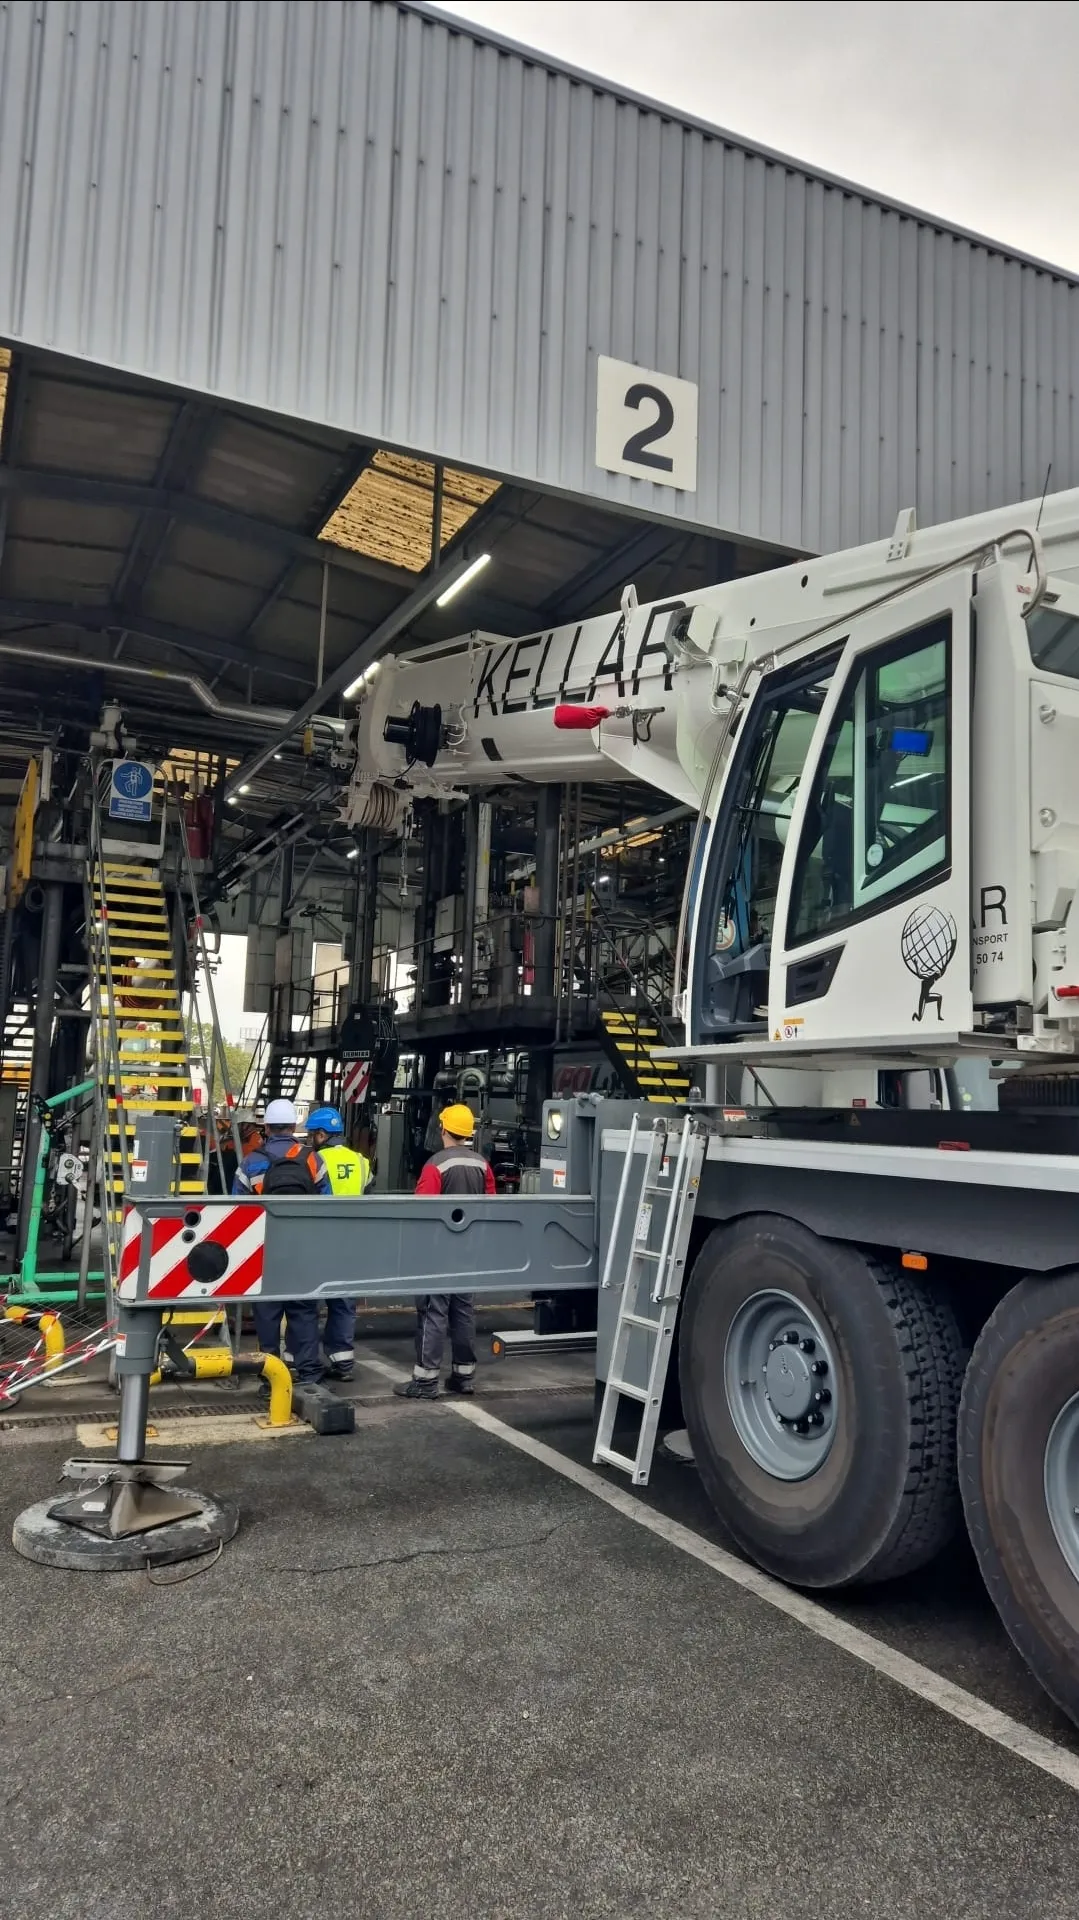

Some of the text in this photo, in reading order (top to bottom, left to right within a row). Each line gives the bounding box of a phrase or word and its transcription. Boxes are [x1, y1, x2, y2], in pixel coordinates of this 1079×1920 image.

[622, 383, 674, 472] 2
[474, 600, 686, 718] KELLAR
[976, 951, 1004, 965] 50 74
[336, 1163, 356, 1180] DF
